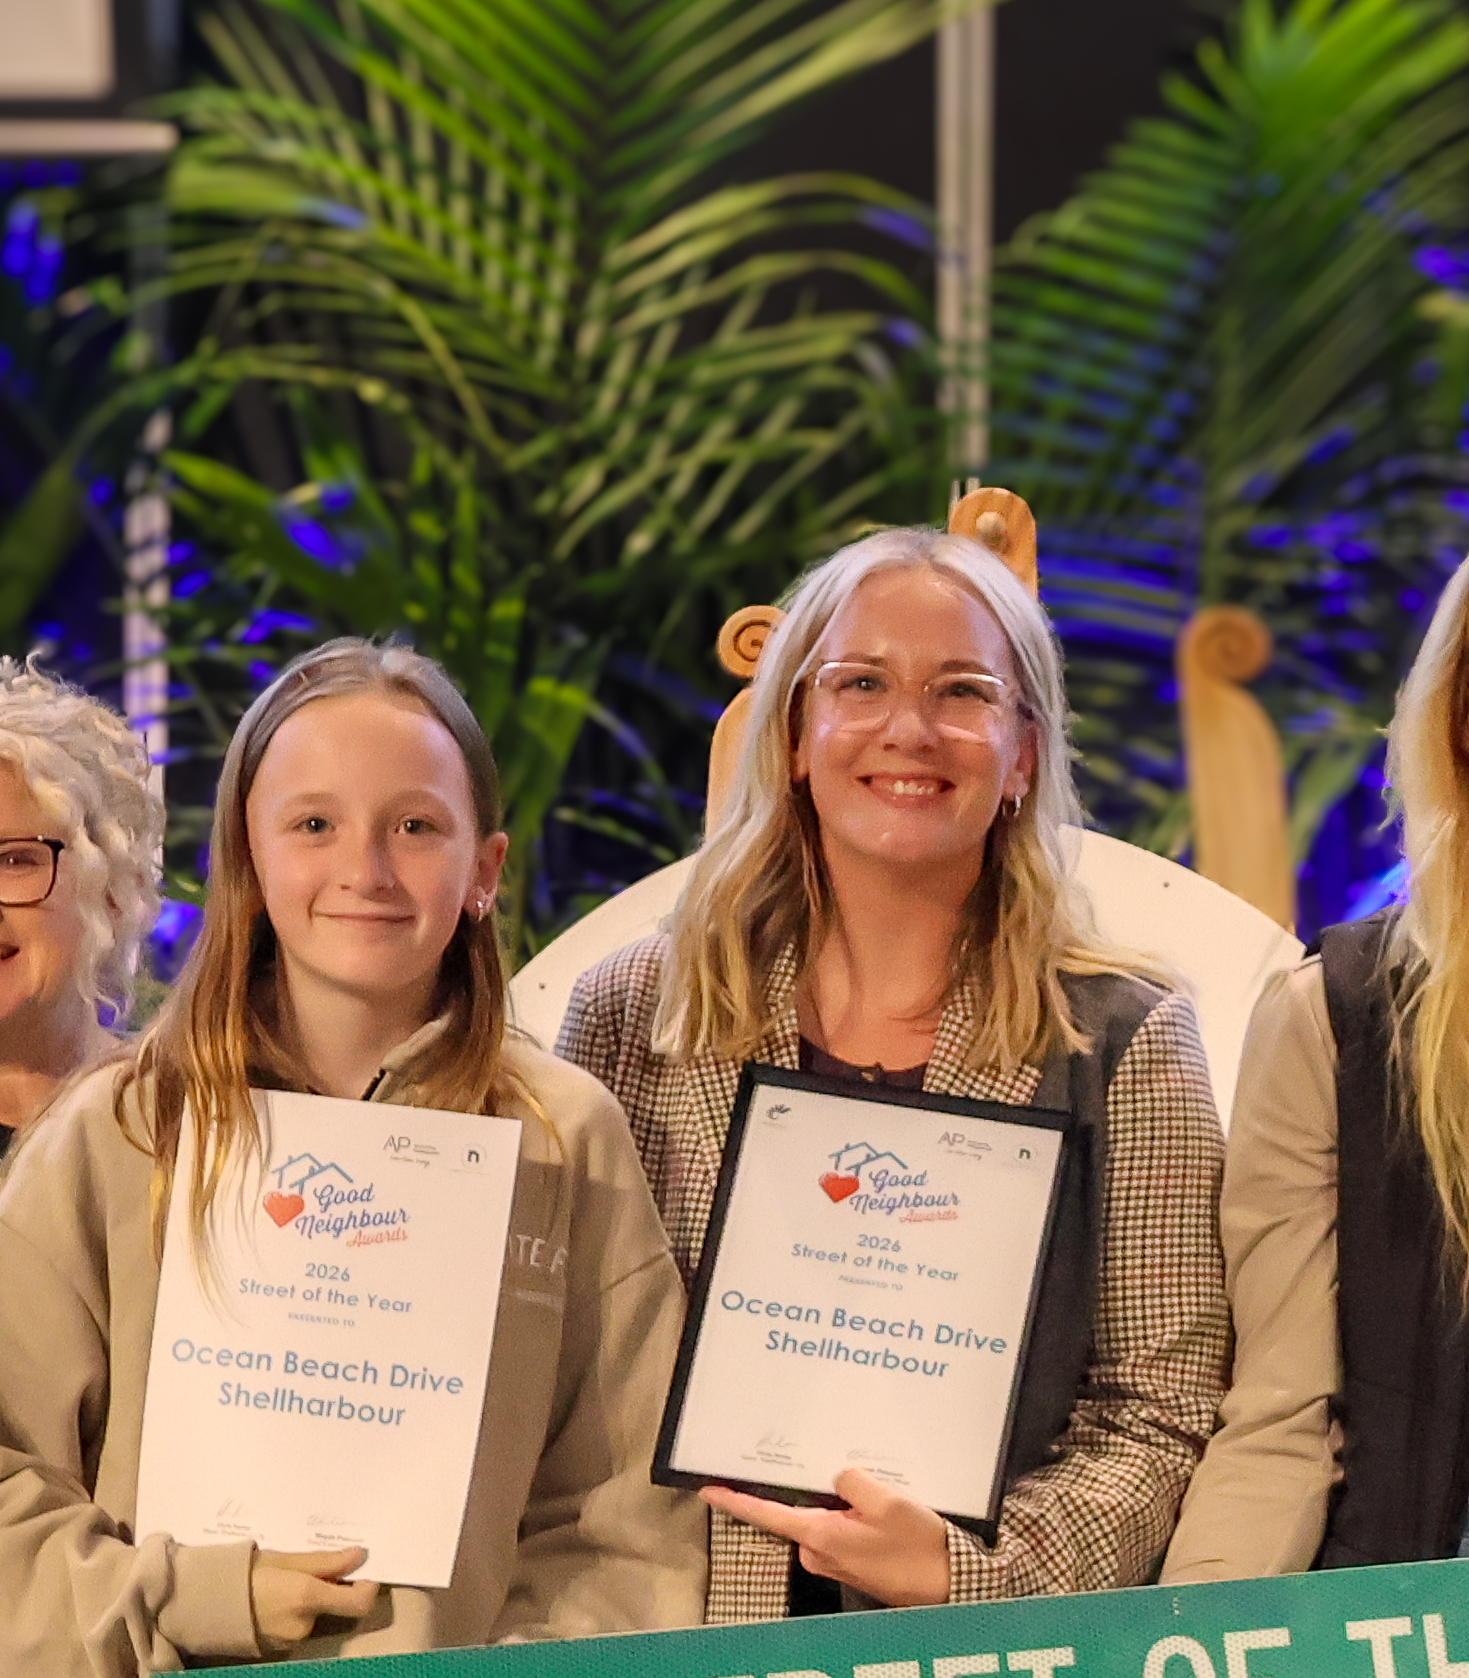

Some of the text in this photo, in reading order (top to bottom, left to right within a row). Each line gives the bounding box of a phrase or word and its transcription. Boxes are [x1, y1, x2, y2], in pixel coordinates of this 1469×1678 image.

[869, 1170, 927, 1190] Good
[313, 1182, 375, 1212] Good
[850, 1192, 960, 1216] Neighbour
[295, 1207, 411, 1238] Neighbour
[347, 1229, 409, 1247] Awards
[857, 1234, 901, 1252] 2026
[305, 1263, 351, 1282] 2026
[791, 1244, 959, 1281] Street of the Year
[239, 1279, 413, 1314] Street of the Year
[721, 1290, 1008, 1355] Ocean Beach Drive
[171, 1339, 464, 1395] Ocean Beach Drive
[765, 1330, 950, 1378] Shellharbour
[218, 1382, 405, 1425] Shellharbour
